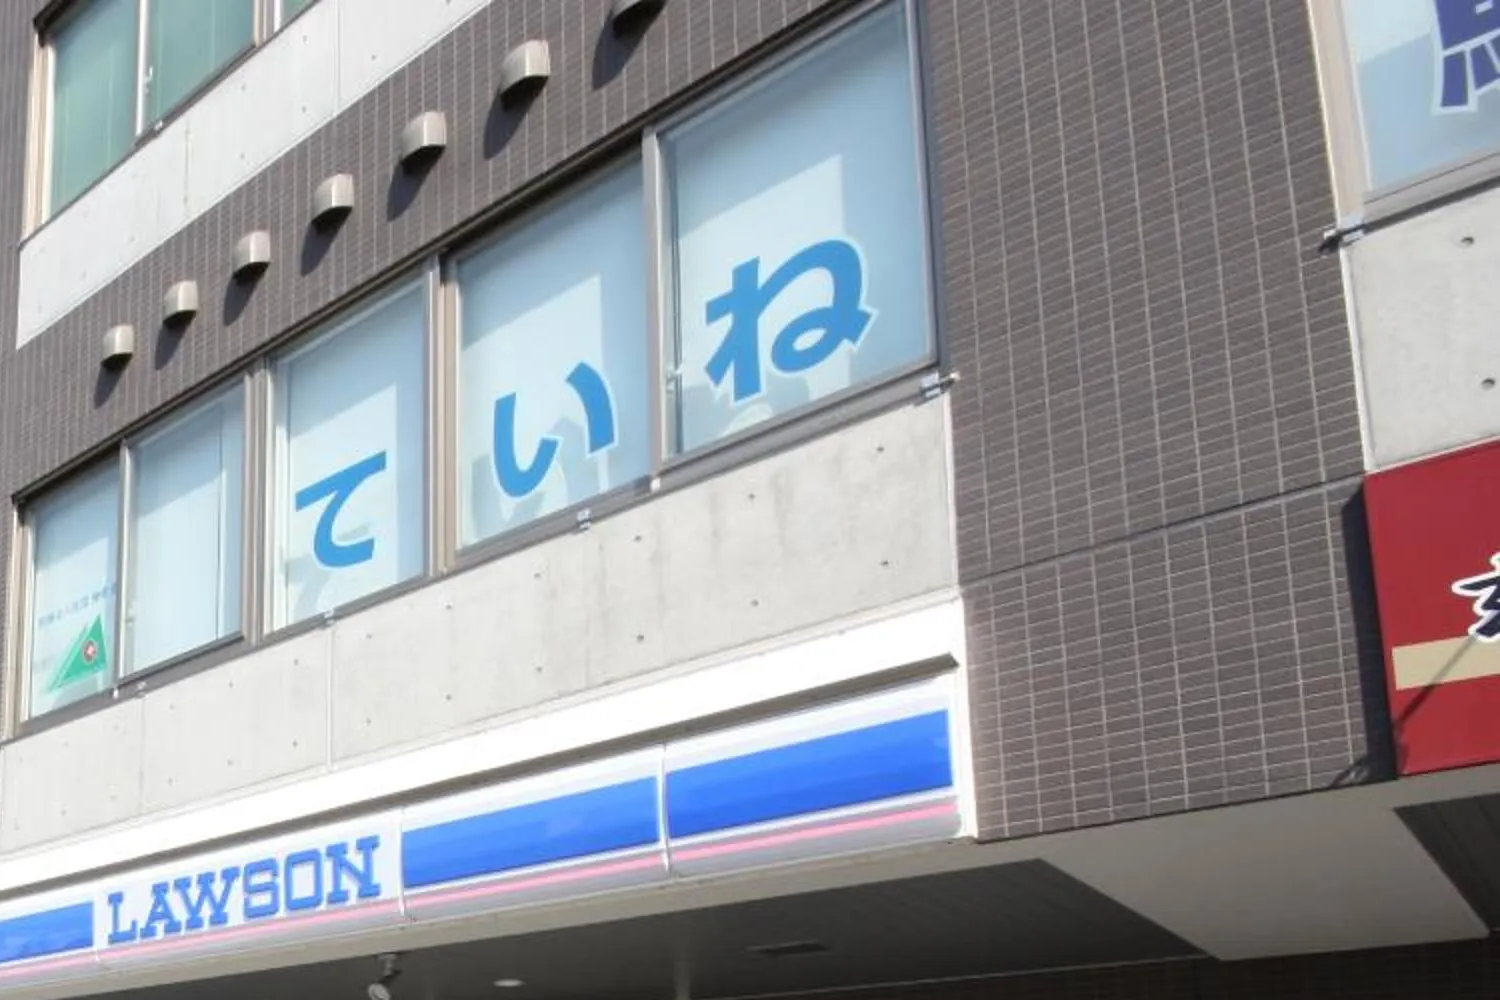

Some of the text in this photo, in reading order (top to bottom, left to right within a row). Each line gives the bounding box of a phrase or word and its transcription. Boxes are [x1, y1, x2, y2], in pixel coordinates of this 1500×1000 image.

[296, 239, 871, 568] ていね
[107, 835, 381, 945] LAWSON
